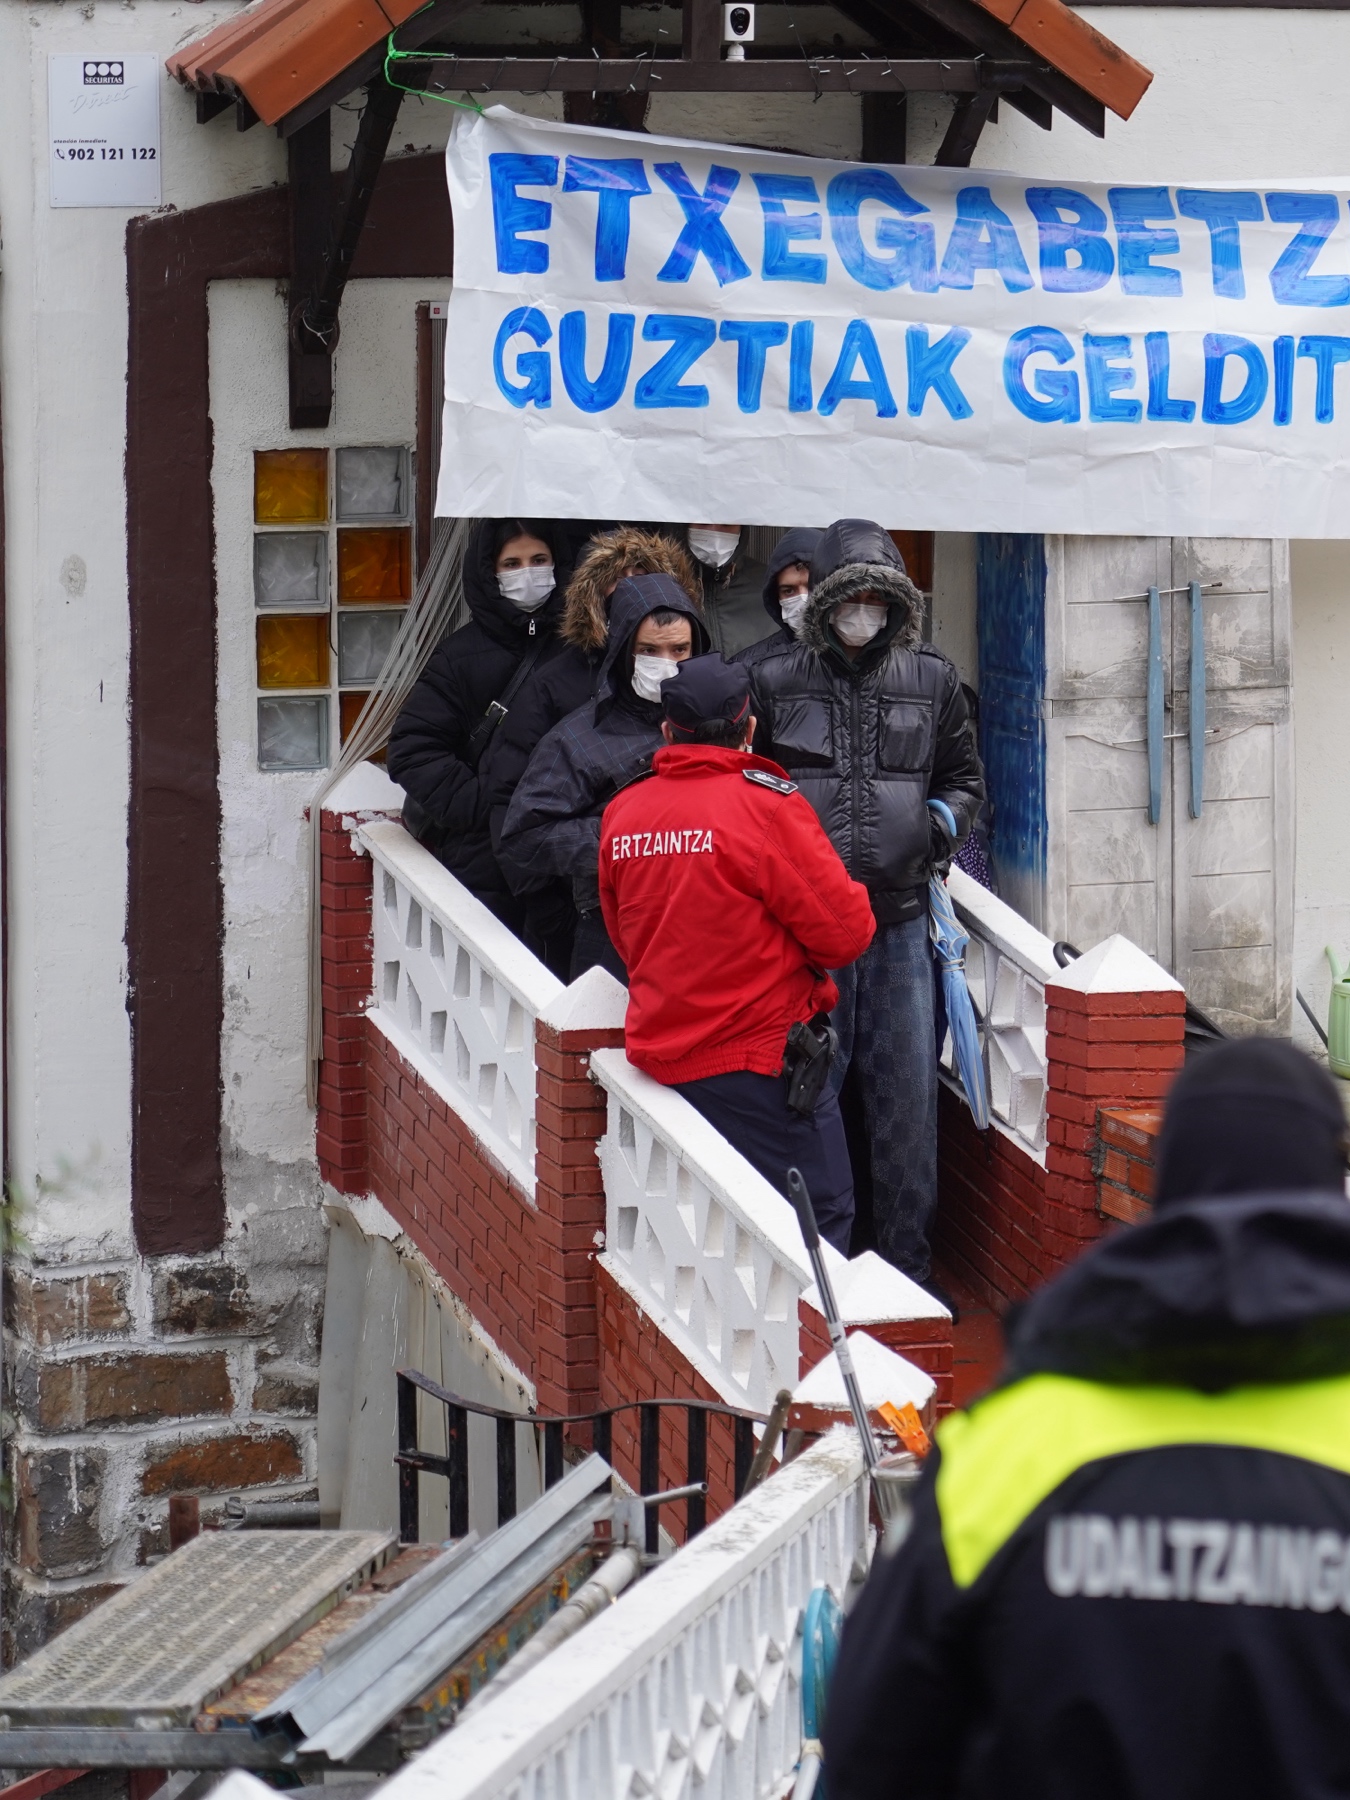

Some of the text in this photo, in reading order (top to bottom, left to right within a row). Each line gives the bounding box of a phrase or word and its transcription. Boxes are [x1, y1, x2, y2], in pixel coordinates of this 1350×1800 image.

[68, 147, 157, 160] 902 121 122
[493, 305, 975, 421] GUZTIAK
[612, 830, 713, 861] ERTZAINTZA
